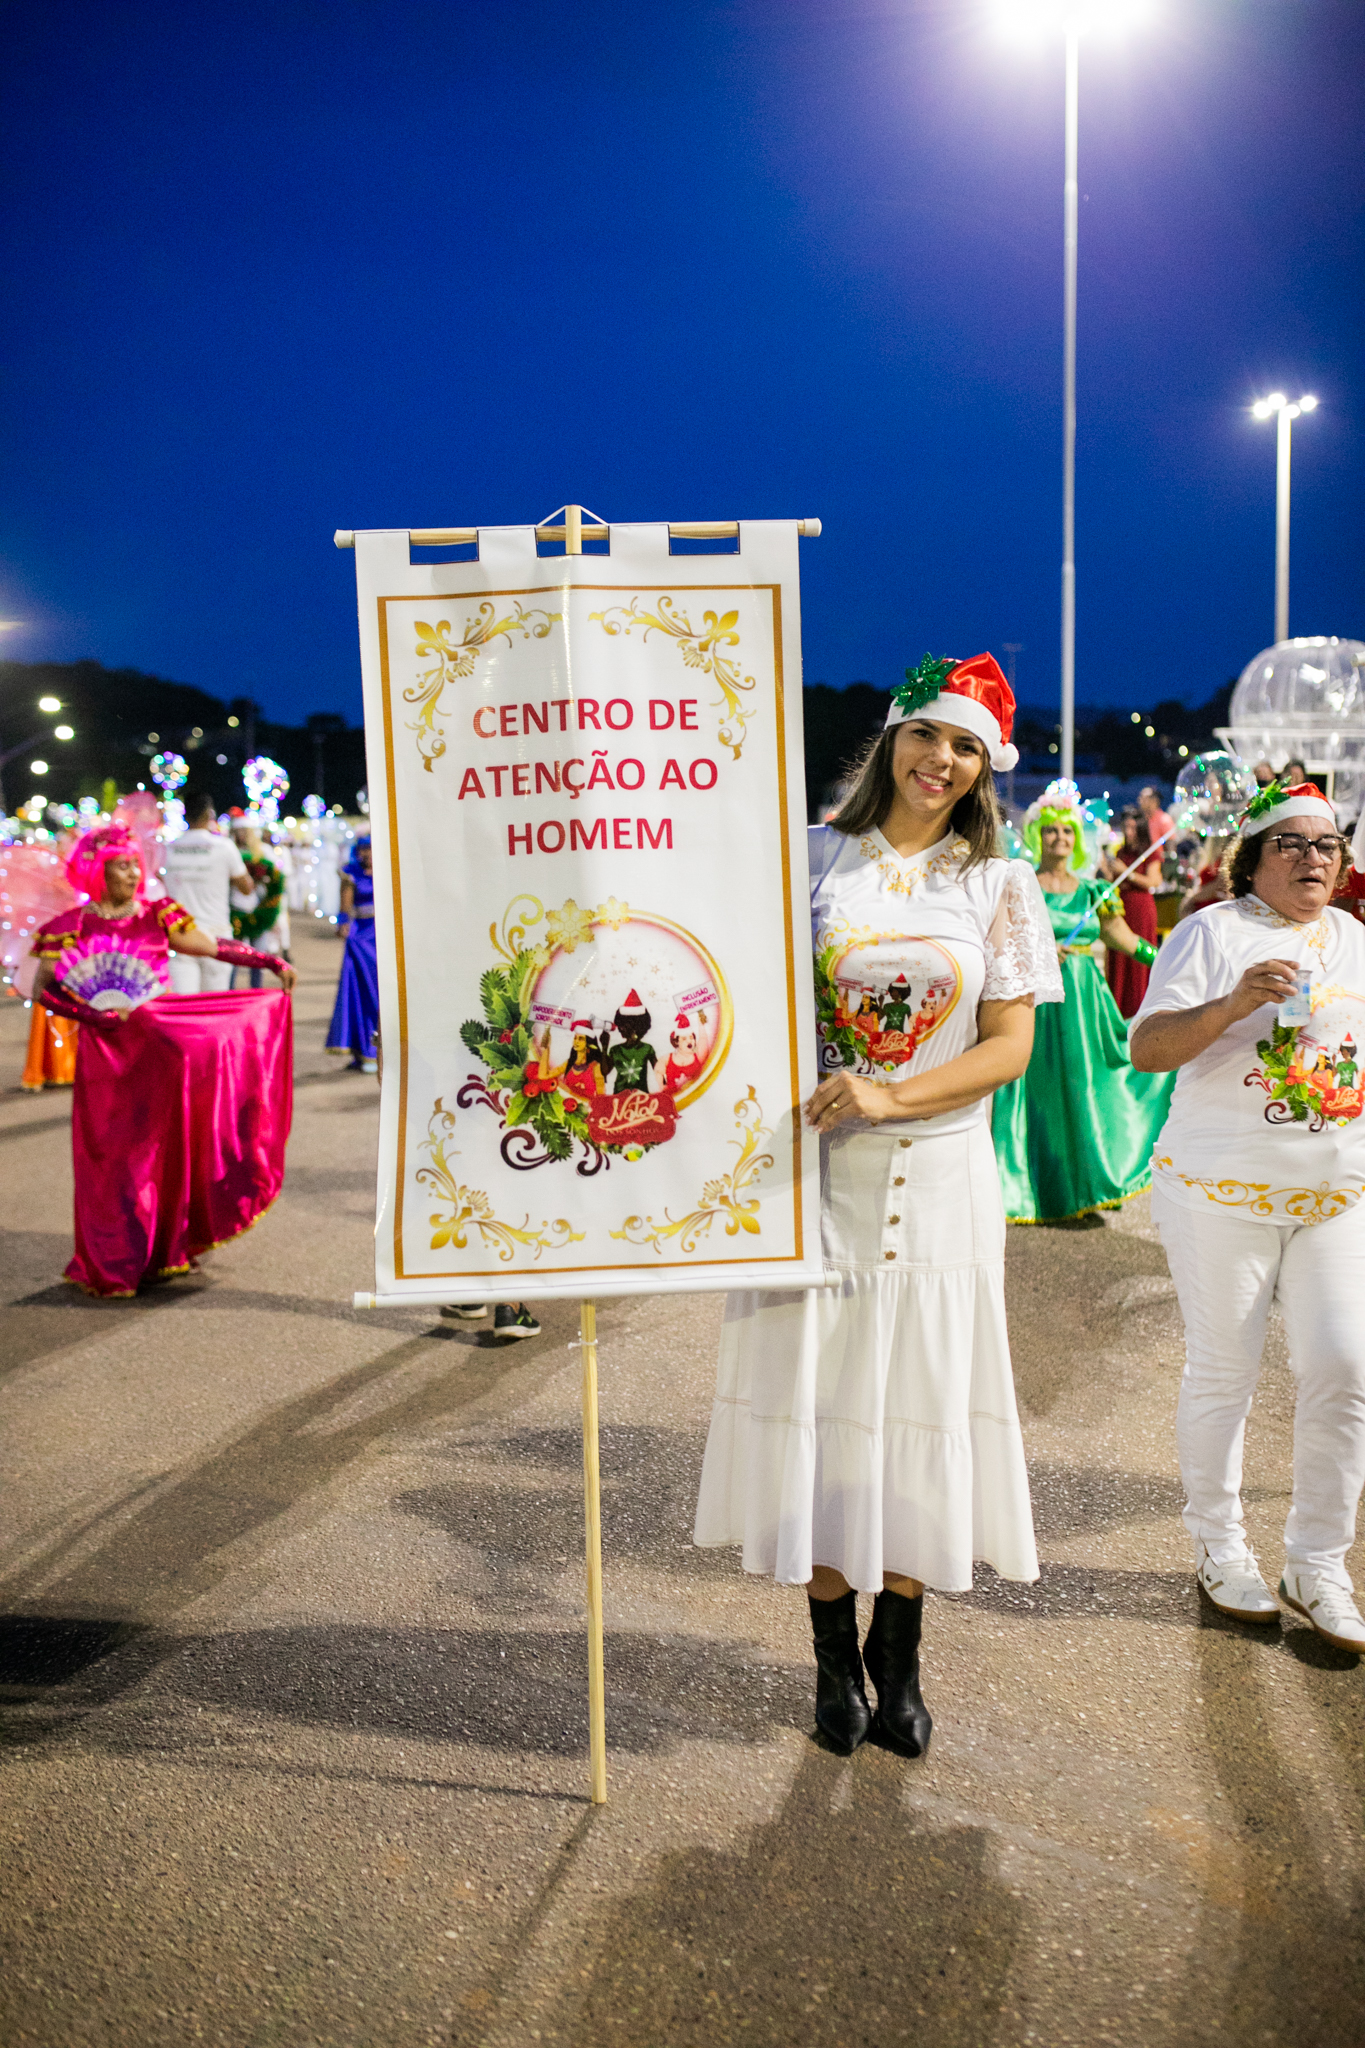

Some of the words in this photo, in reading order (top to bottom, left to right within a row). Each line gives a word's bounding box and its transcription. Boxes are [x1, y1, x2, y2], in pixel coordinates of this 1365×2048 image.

[473, 698, 634, 738] CENTRO
[648, 699, 699, 731] DE
[457, 750, 646, 800] ATENÇÃO
[659, 758, 718, 790] AO
[507, 818, 673, 856] HOMEM
[682, 987, 709, 1003] INCLUSÃO
[598, 1089, 665, 1130] Natal
